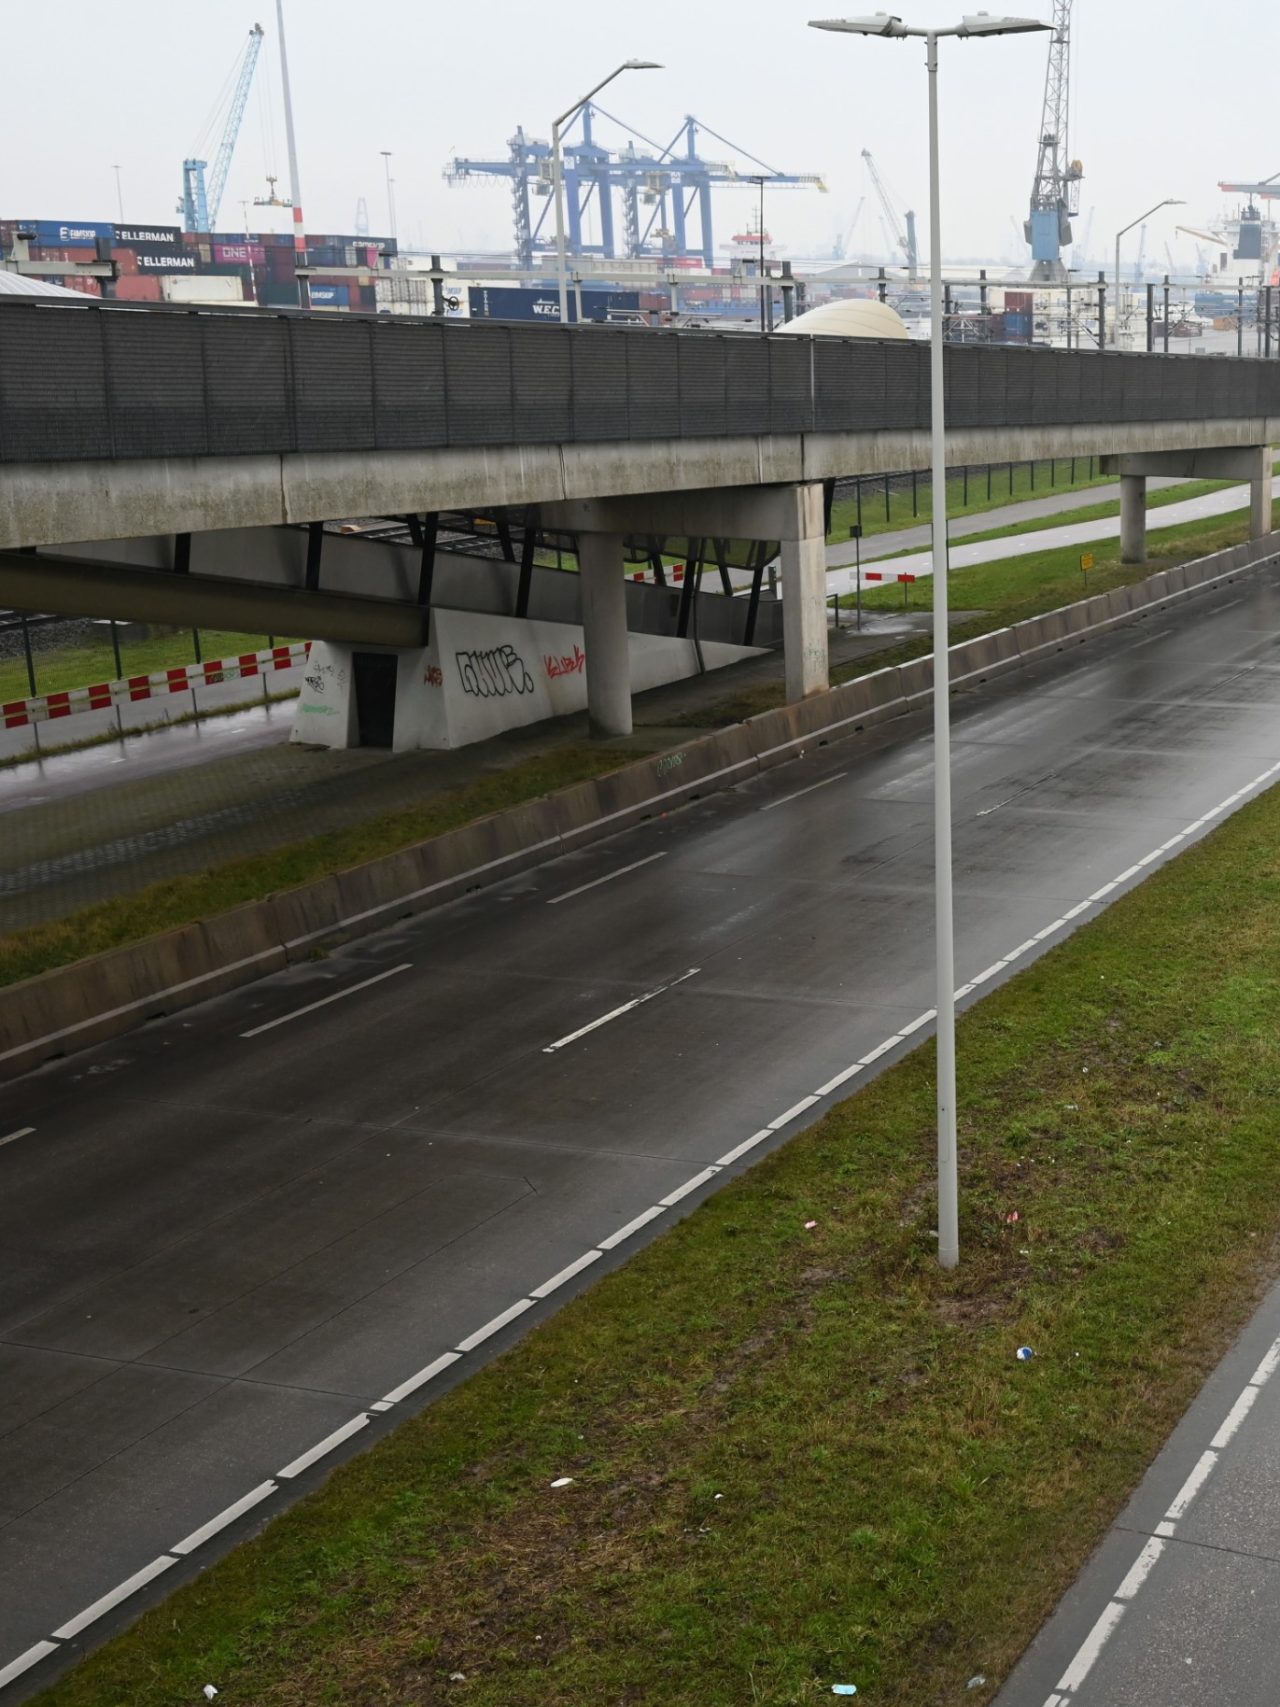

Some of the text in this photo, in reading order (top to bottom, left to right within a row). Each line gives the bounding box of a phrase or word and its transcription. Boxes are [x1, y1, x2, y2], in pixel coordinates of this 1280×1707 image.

[121, 231, 174, 242] ELLERMAN
[222, 246, 247, 258] ONE
[143, 256, 195, 268] ELLERMAN
